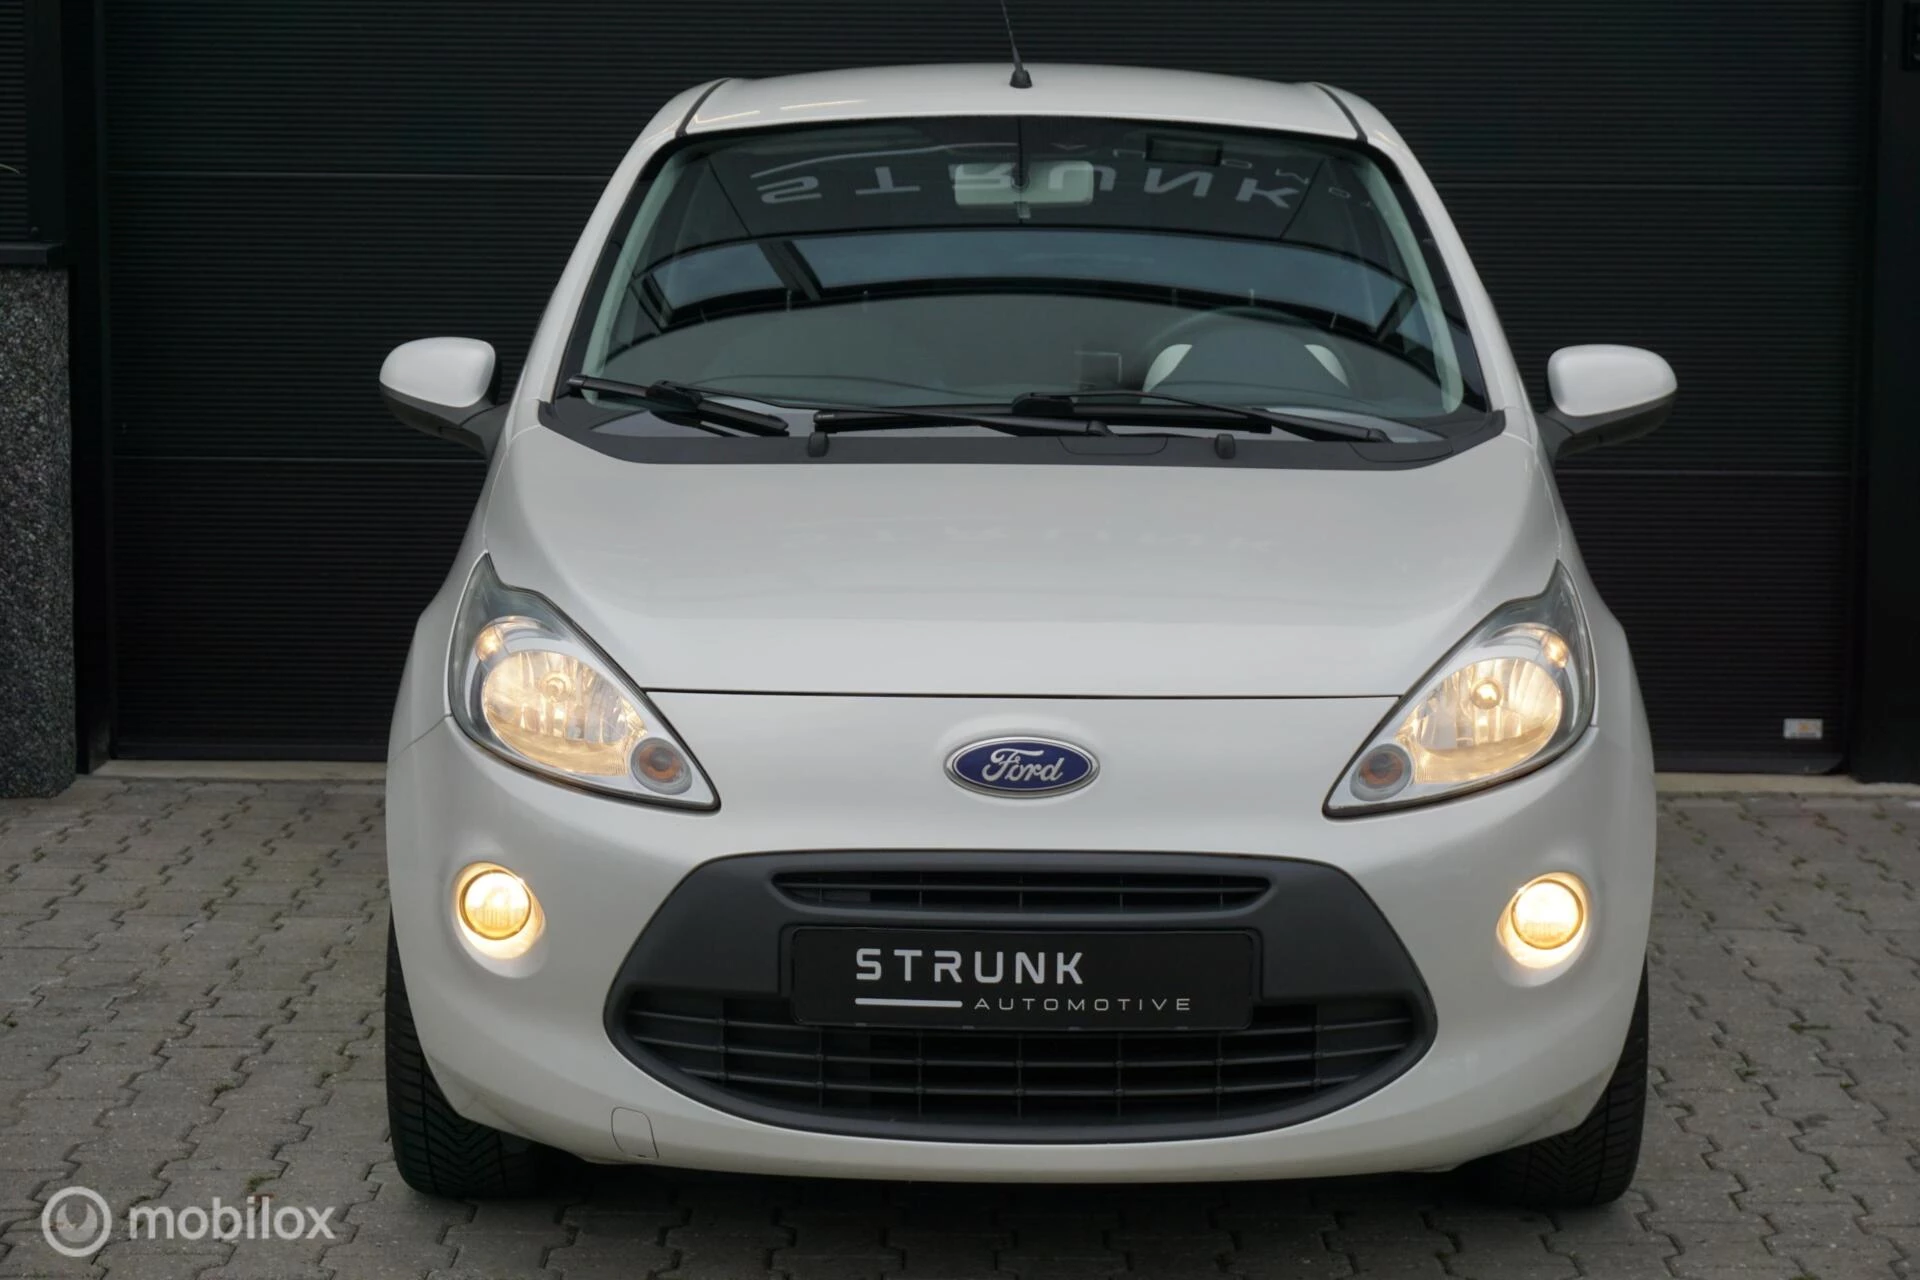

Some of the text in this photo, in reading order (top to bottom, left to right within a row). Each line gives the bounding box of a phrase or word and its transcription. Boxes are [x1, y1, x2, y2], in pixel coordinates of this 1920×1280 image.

[981, 748, 1063, 783] Ford
[855, 948, 1084, 984] STRUNK
[973, 998, 1191, 1012] AUTOMOTIVE
